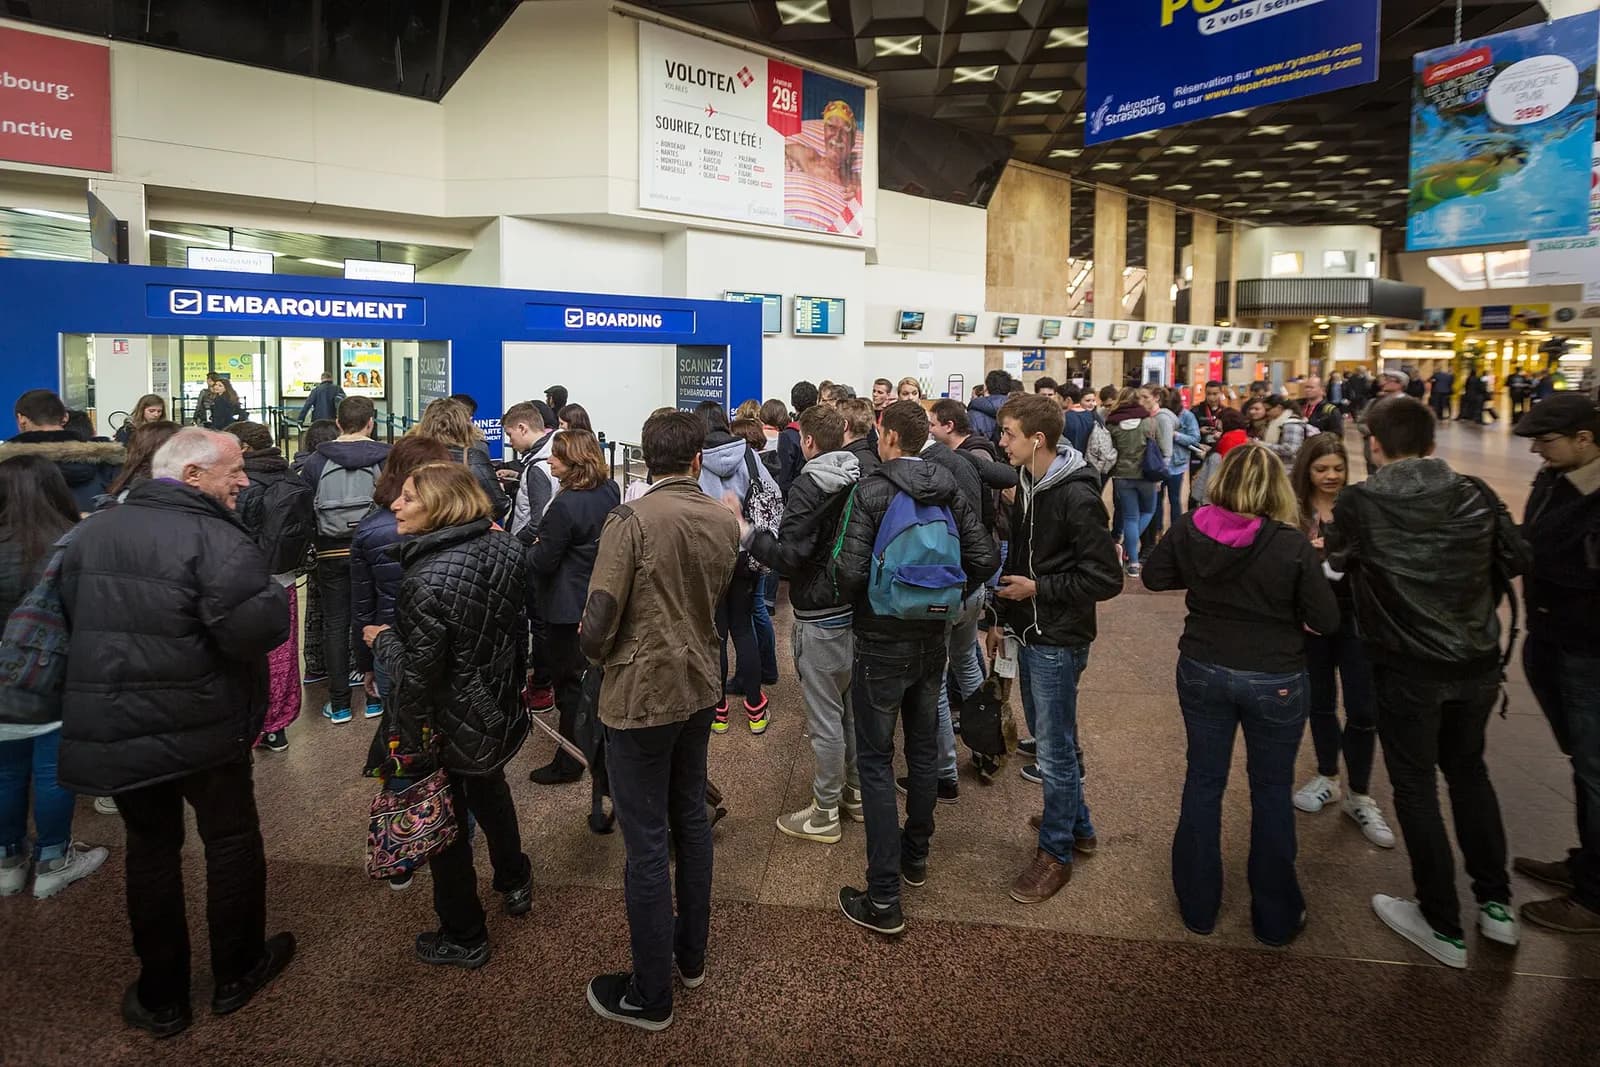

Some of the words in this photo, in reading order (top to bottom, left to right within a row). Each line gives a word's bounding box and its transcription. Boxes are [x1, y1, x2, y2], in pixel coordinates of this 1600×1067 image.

[1206, 18, 1215, 30] 2
[665, 59, 736, 94] VOLOTEA
[1174, 76, 1233, 97] Réservation
[1234, 70, 1253, 82] sur
[1254, 42, 1362, 76] www.ryanair.com
[0, 72, 74, 100] bourg.
[1173, 100, 1186, 109] ou
[1187, 95, 1204, 105] sur
[1203, 57, 1362, 101] www.departstrasbourg.com
[1118, 95, 1160, 113] Aéroport
[1104, 102, 1166, 126] Strasbourg
[2, 120, 73, 141] nctive
[655, 115, 703, 139] SOURIEZ,
[705, 125, 731, 143] C'EST
[733, 130, 757, 148] L'ÉTÉ
[660, 149, 679, 158] NANTES
[660, 157, 692, 167] MONTPELLIER
[207, 295, 408, 320] EMBARQUEMENT
[586, 311, 662, 328] BOARDING
[680, 358, 723, 373] SCANNEZ
[680, 375, 700, 386] VOTRE
[701, 376, 723, 387] CARTE
[680, 388, 723, 398] D'EMBARQUEMENT
[474, 418, 502, 428] NNEZ
